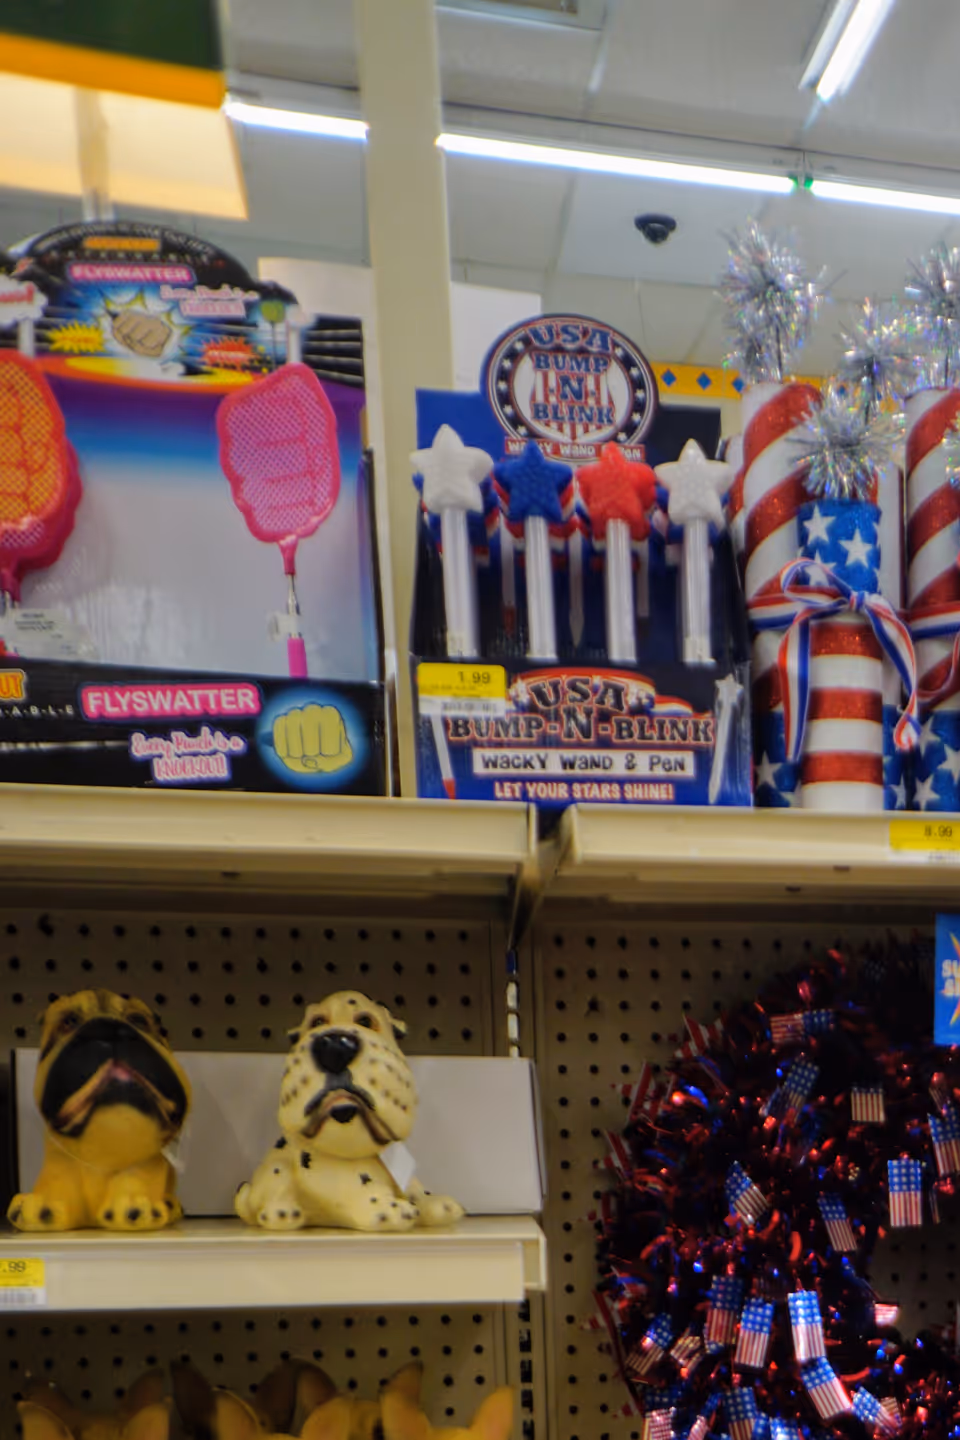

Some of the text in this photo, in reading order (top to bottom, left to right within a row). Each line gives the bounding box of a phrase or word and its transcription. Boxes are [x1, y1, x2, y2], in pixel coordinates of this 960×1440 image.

[71, 264, 188, 282] FLYSWATTER
[528, 324, 613, 352] USA
[535, 352, 608, 373] BUMP
[534, 403, 614, 425] BLINK
[86, 688, 255, 714] FLYSWATTER
[530, 677, 627, 713] USA
[154, 754, 226, 778] KNOCKOUT!
[624, 754, 637, 771] &
[495, 782, 674, 801] LET YOUR STARS SHINE!
